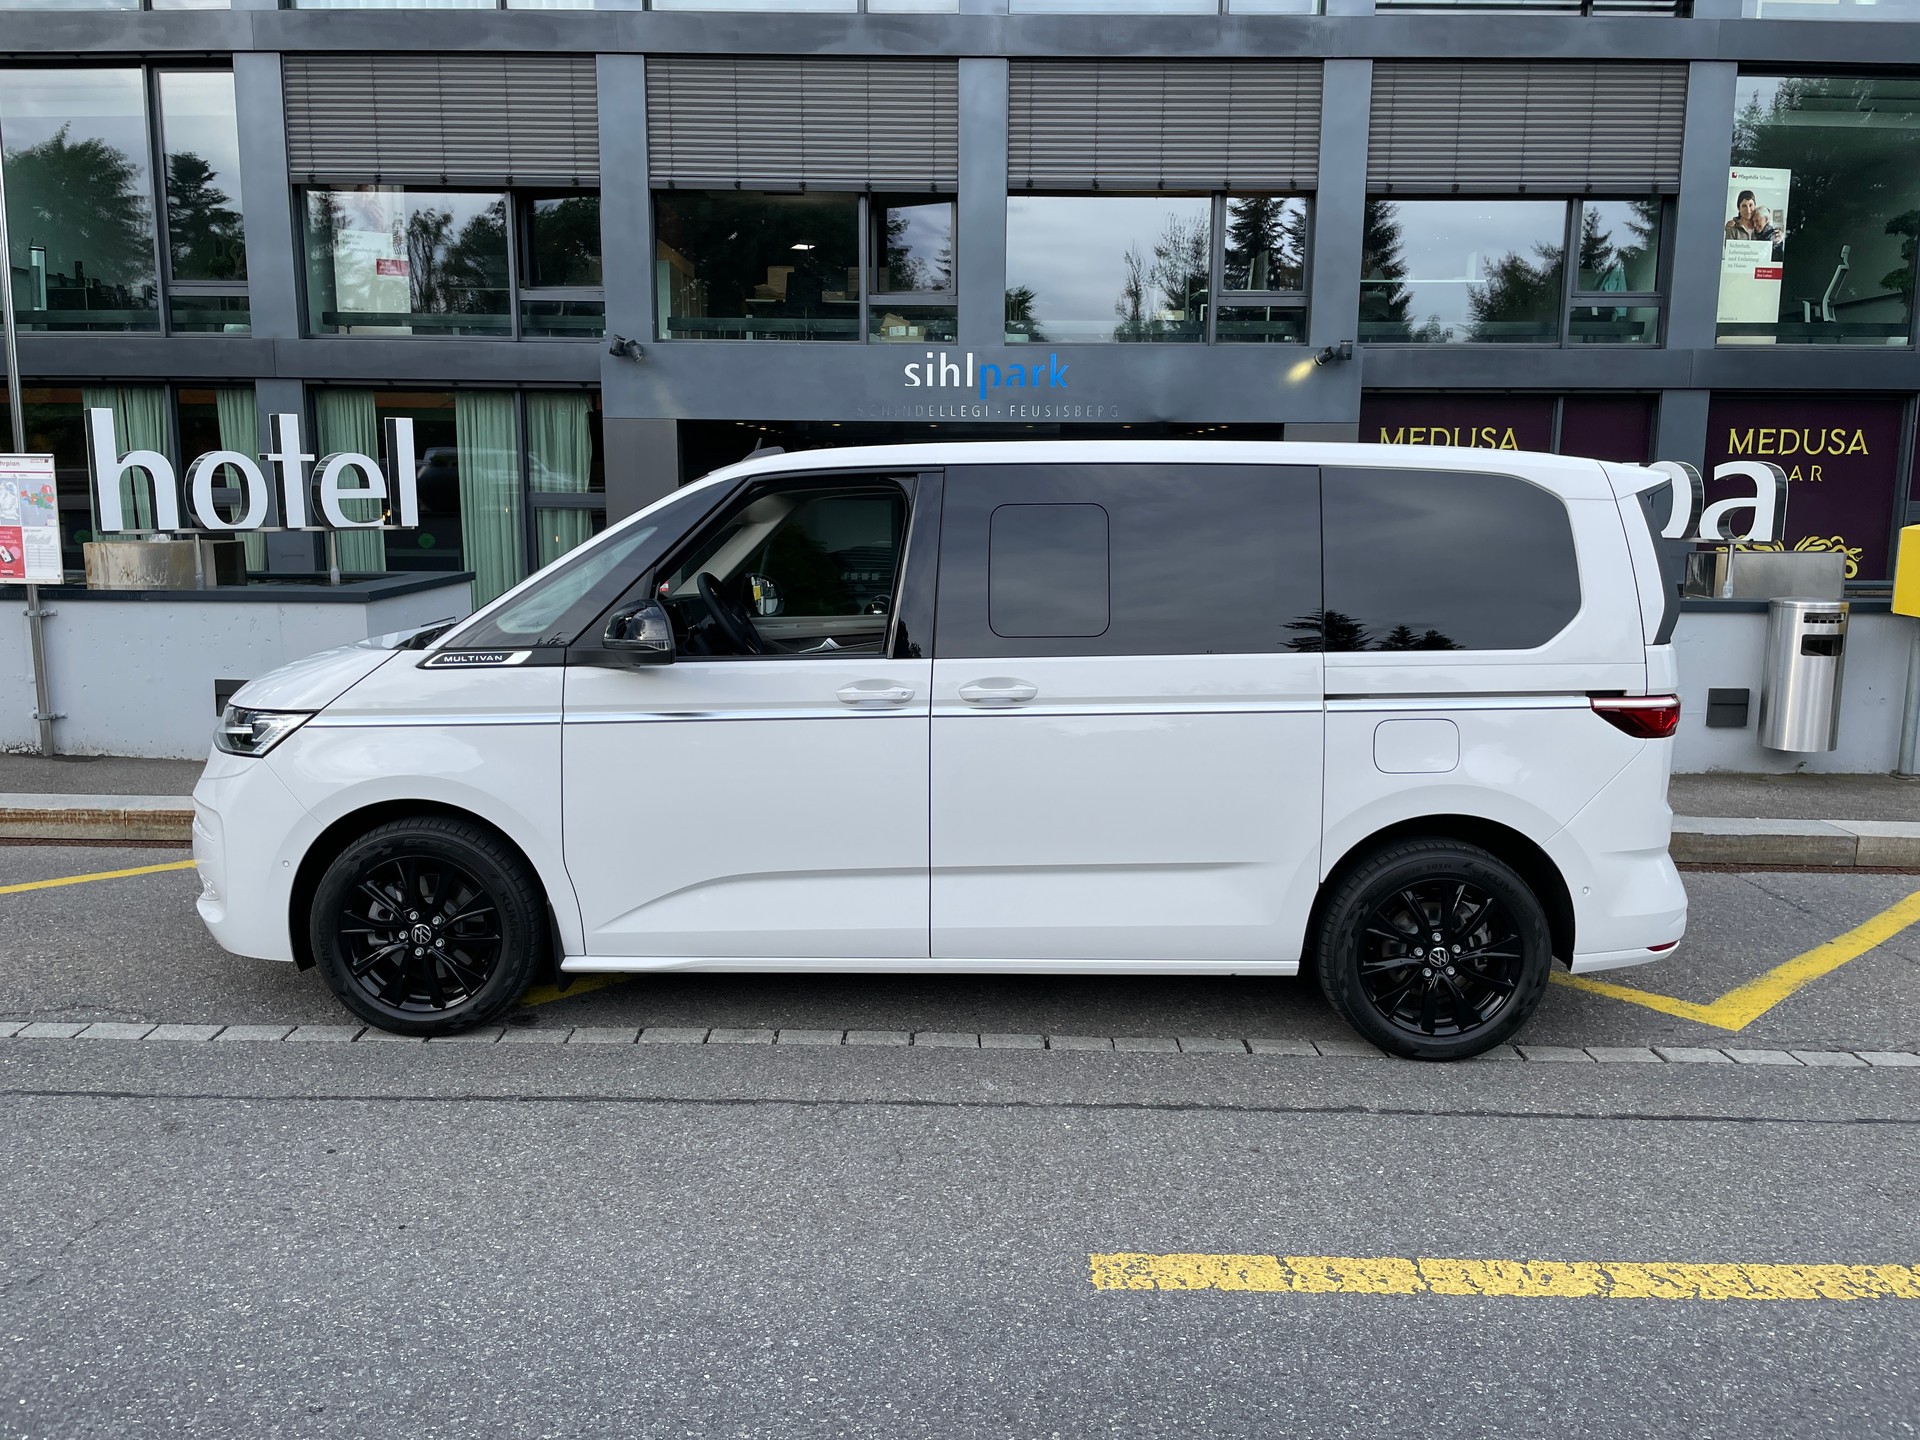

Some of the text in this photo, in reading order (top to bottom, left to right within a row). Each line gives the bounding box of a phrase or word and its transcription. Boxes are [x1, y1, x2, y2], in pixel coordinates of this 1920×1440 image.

[904, 352, 1069, 400] sihlpark
[1380, 427, 1519, 450] MEDUSA
[1727, 428, 1869, 455] MEDUSA
[85, 407, 418, 531] hotel
[1788, 465, 1823, 481] AR
[443, 655, 503, 663] MULTIVAN
